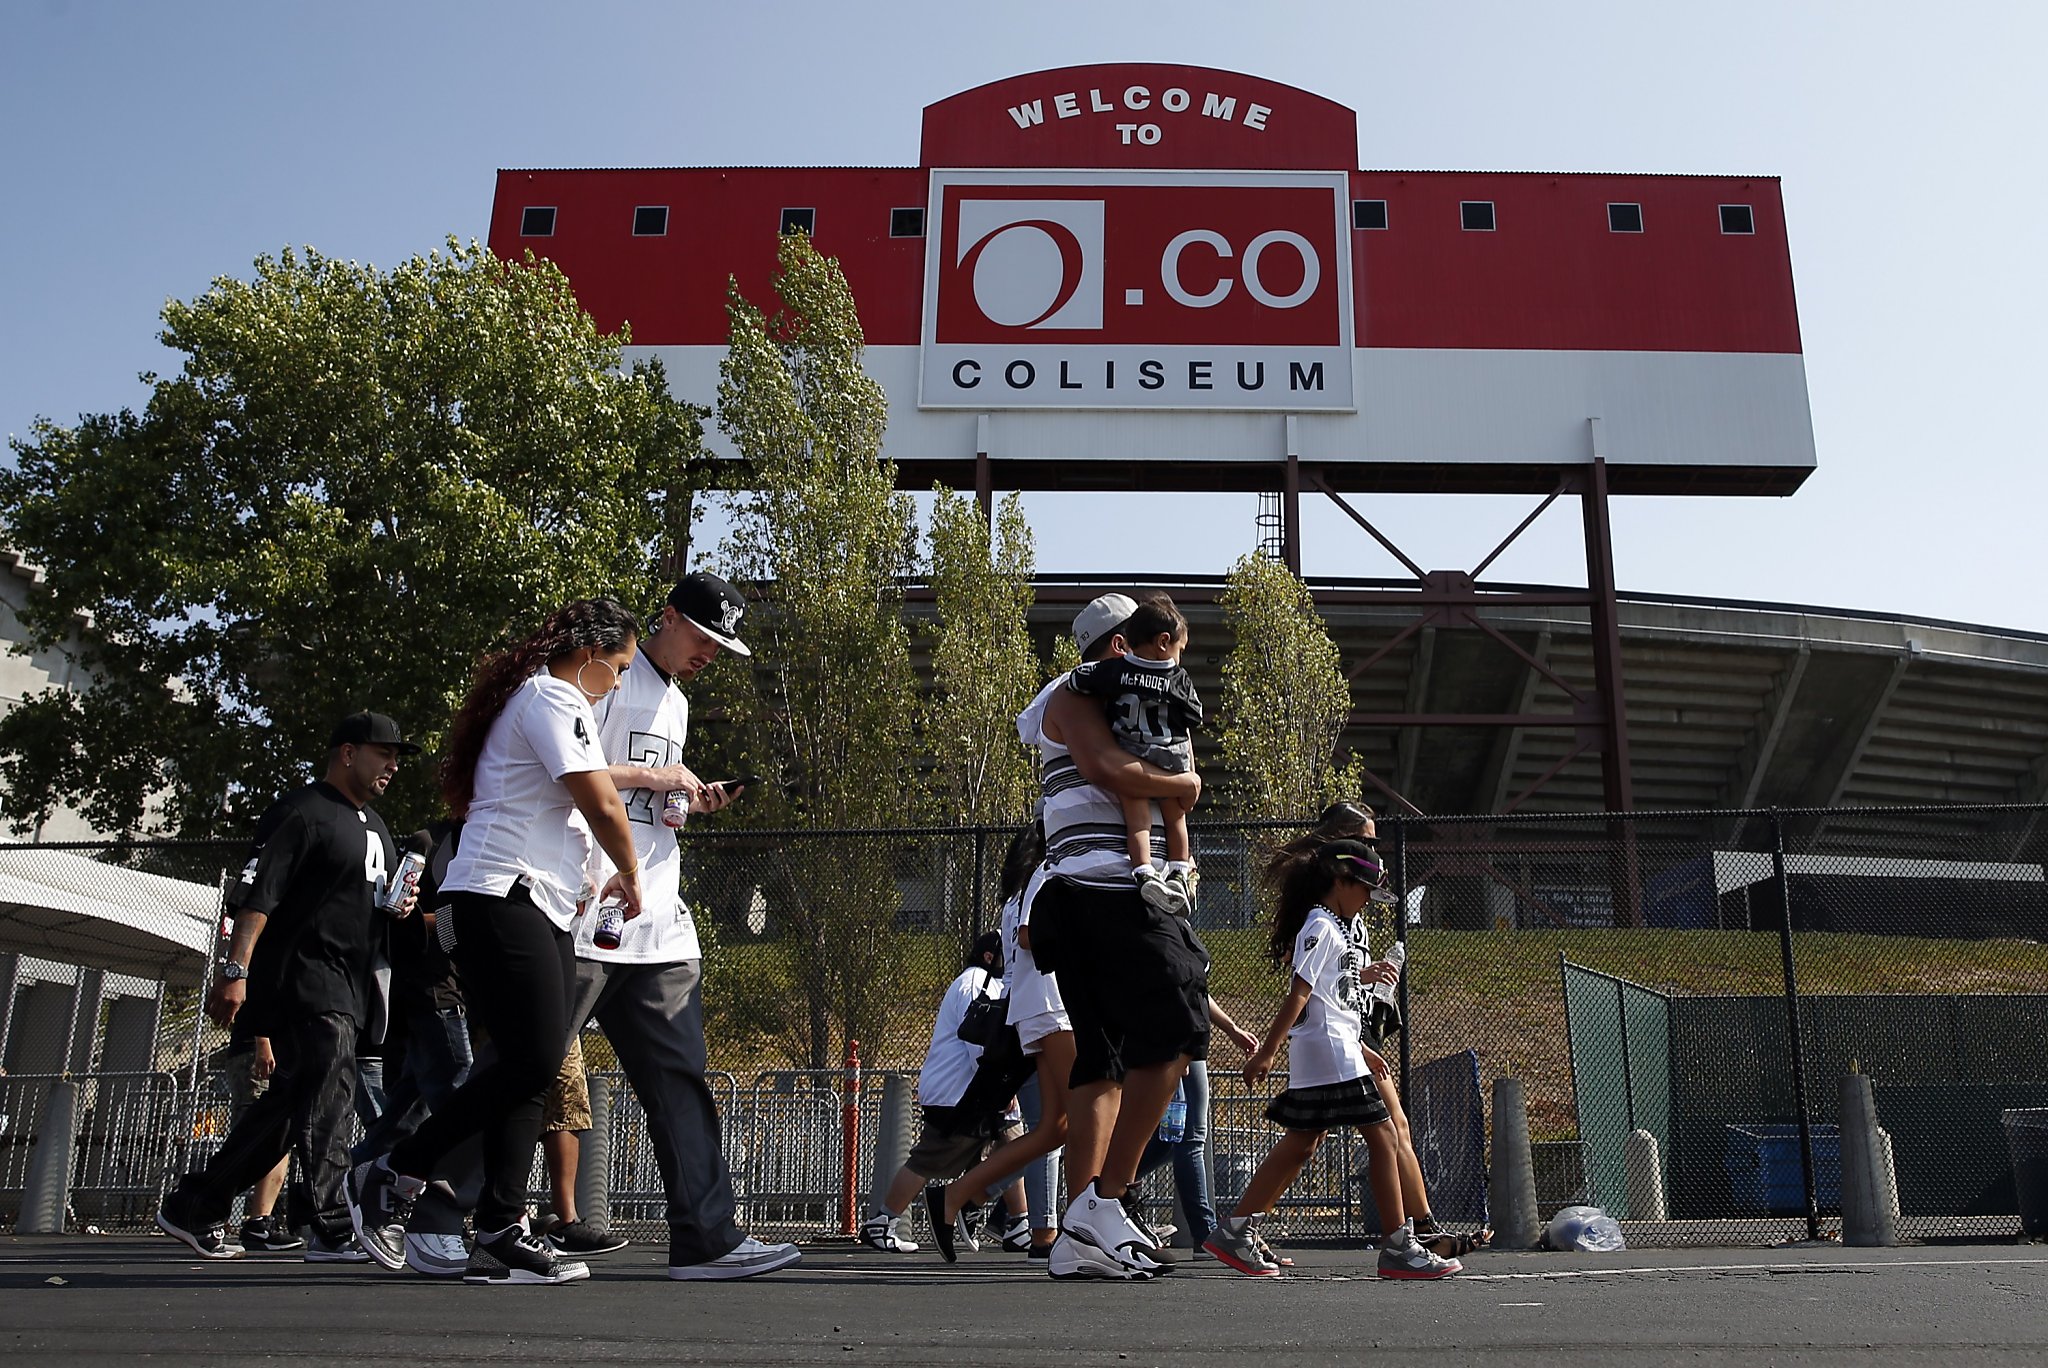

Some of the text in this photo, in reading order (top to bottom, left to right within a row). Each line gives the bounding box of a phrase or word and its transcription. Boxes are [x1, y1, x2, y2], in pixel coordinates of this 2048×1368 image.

[1008, 85, 1272, 131] WELCOME
[1116, 123, 1162, 145] TO
[951, 359, 1325, 391] COLISEUM
[1120, 672, 1170, 693] McFADDEN
[1111, 693, 1173, 745] 20
[241, 857, 259, 885] 4
